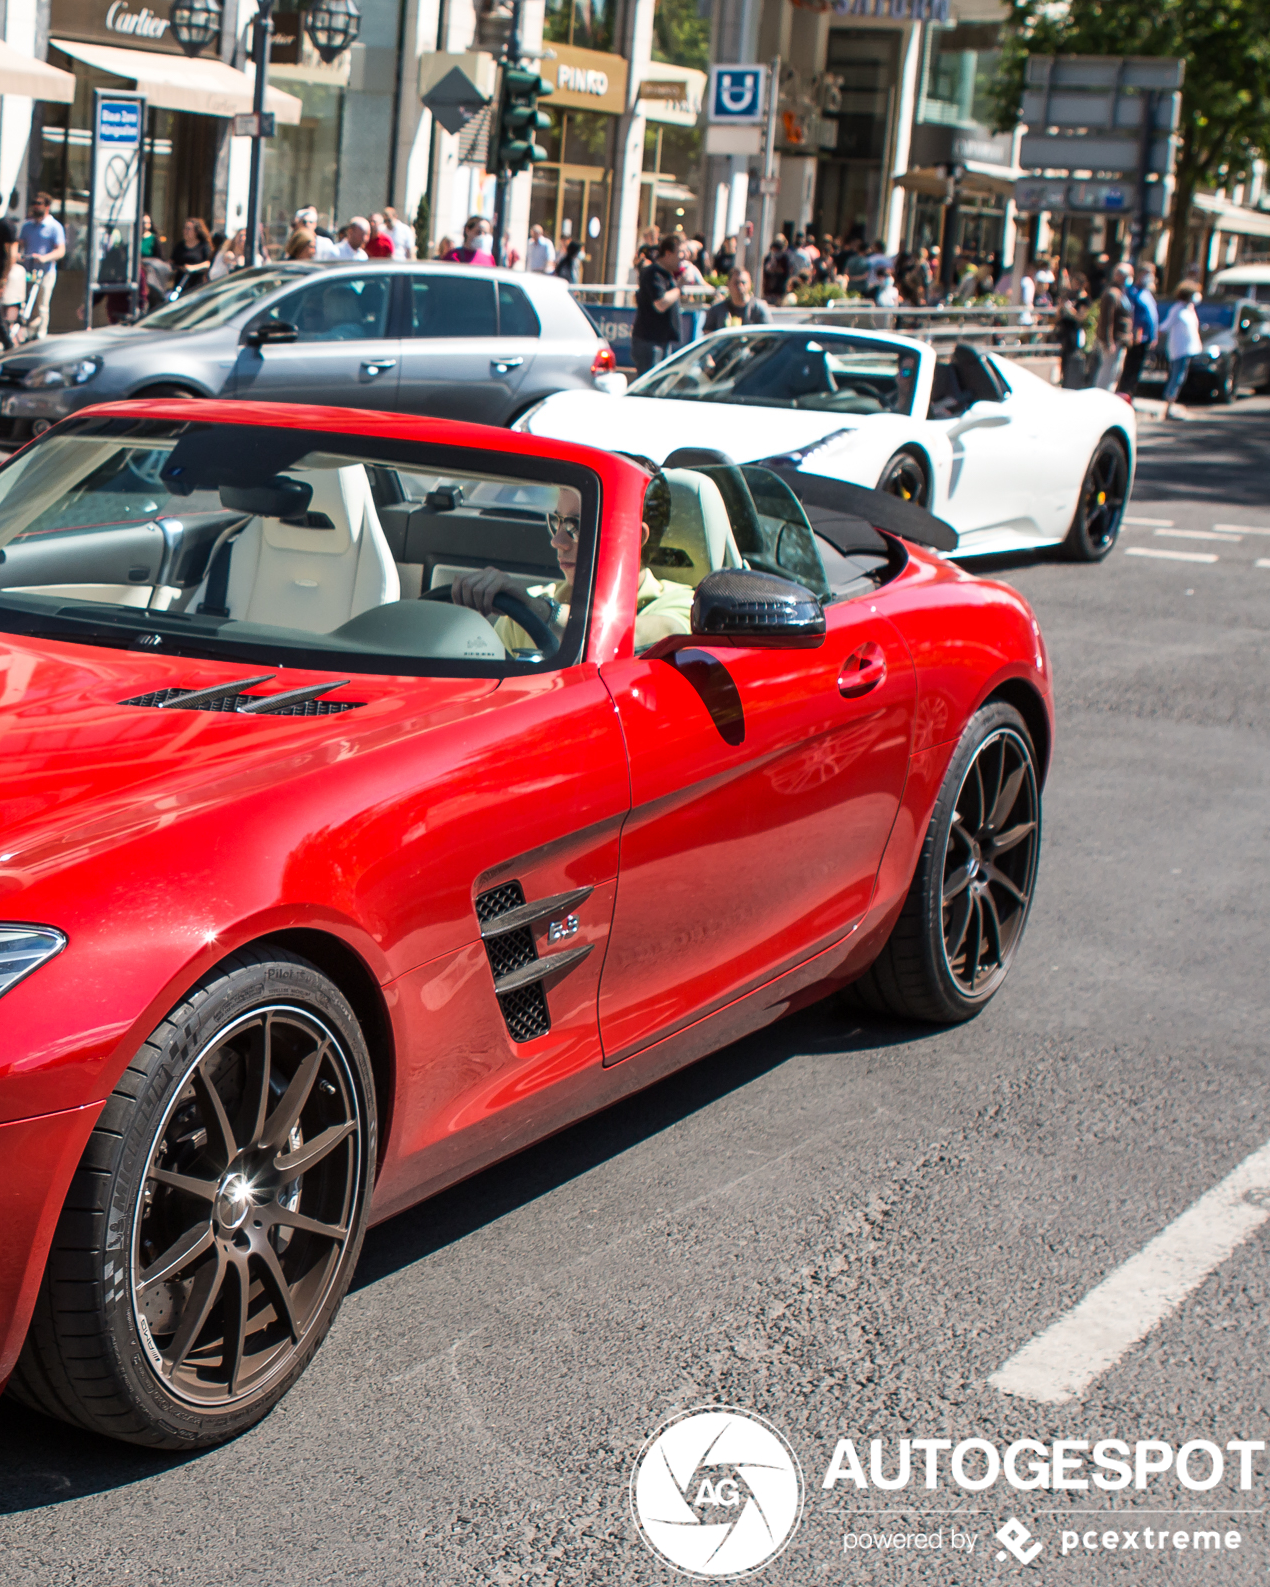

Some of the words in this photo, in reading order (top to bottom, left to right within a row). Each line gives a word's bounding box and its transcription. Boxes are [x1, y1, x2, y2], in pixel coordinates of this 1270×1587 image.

[106, 0, 171, 38] Cartier
[558, 64, 609, 96] PINKO
[596, 316, 634, 341] igs
[267, 968, 294, 980] Pilot
[113, 1063, 171, 1213] MICHELIN
